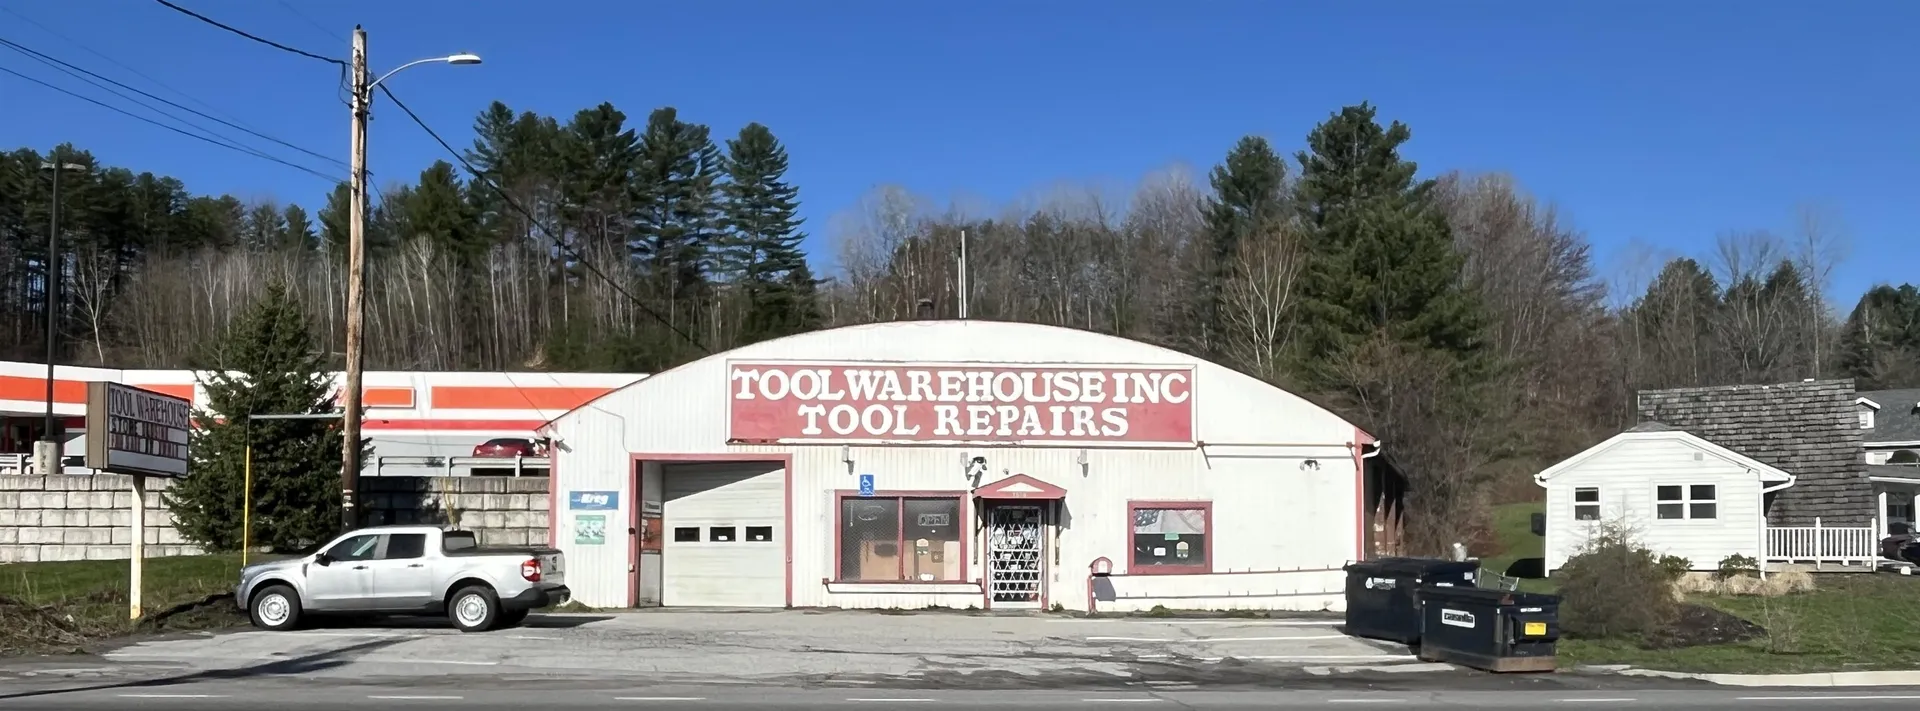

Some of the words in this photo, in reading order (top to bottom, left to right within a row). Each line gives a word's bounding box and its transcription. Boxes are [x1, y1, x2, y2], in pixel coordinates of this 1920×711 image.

[732, 369, 845, 400] TOOL
[844, 369, 1106, 402] WAREHOUSE
[1112, 372, 1189, 403] INC
[111, 388, 135, 418] TOOL
[136, 394, 188, 428] WAREHOUSE
[798, 404, 920, 435] TOOL
[934, 405, 1129, 437] REPAIRS
